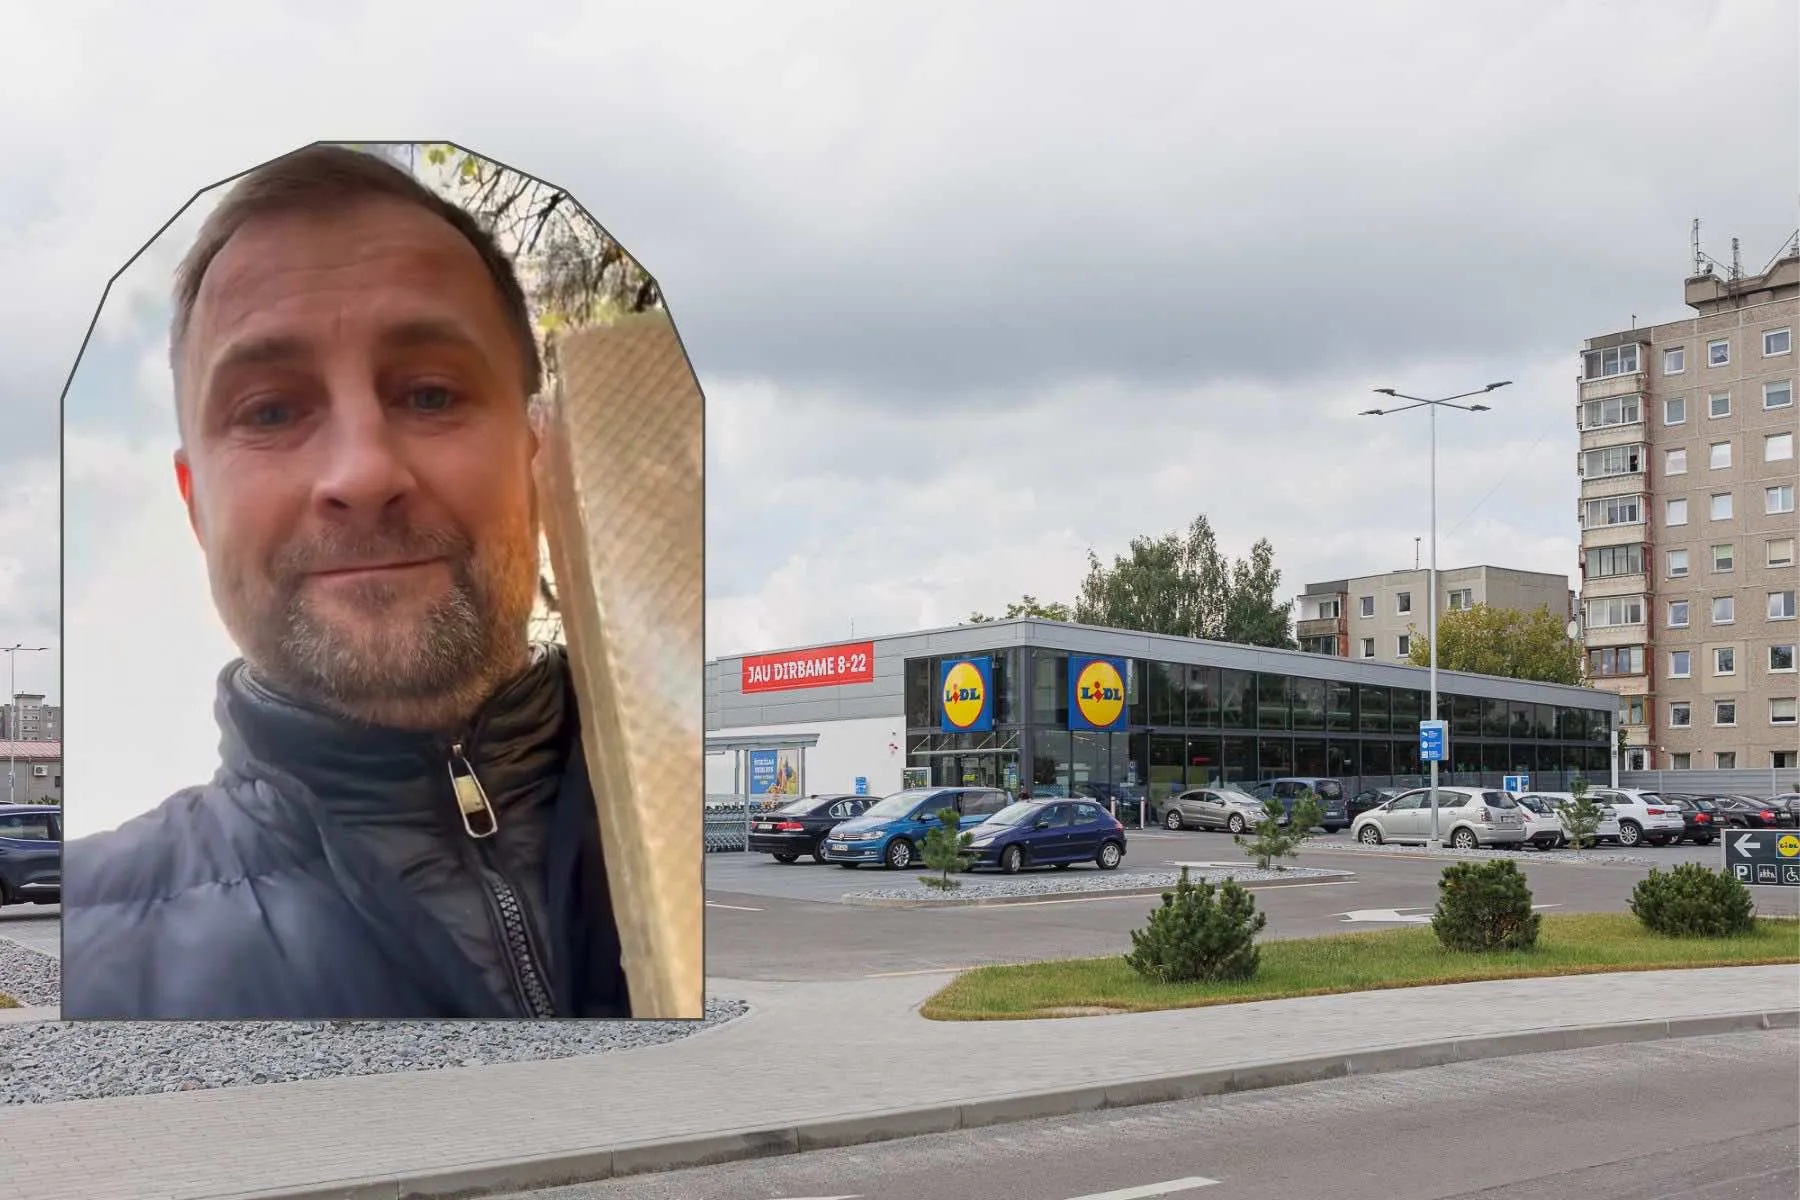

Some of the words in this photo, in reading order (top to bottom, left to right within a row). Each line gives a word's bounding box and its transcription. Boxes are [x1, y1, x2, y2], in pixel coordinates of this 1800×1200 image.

[748, 664, 771, 684] JAU
[773, 656, 835, 681] DIRBAME
[837, 653, 867, 674] 8-22
[945, 682, 981, 705] LIDL
[1080, 681, 1122, 704] LIDL
[1736, 865, 1749, 881] P
